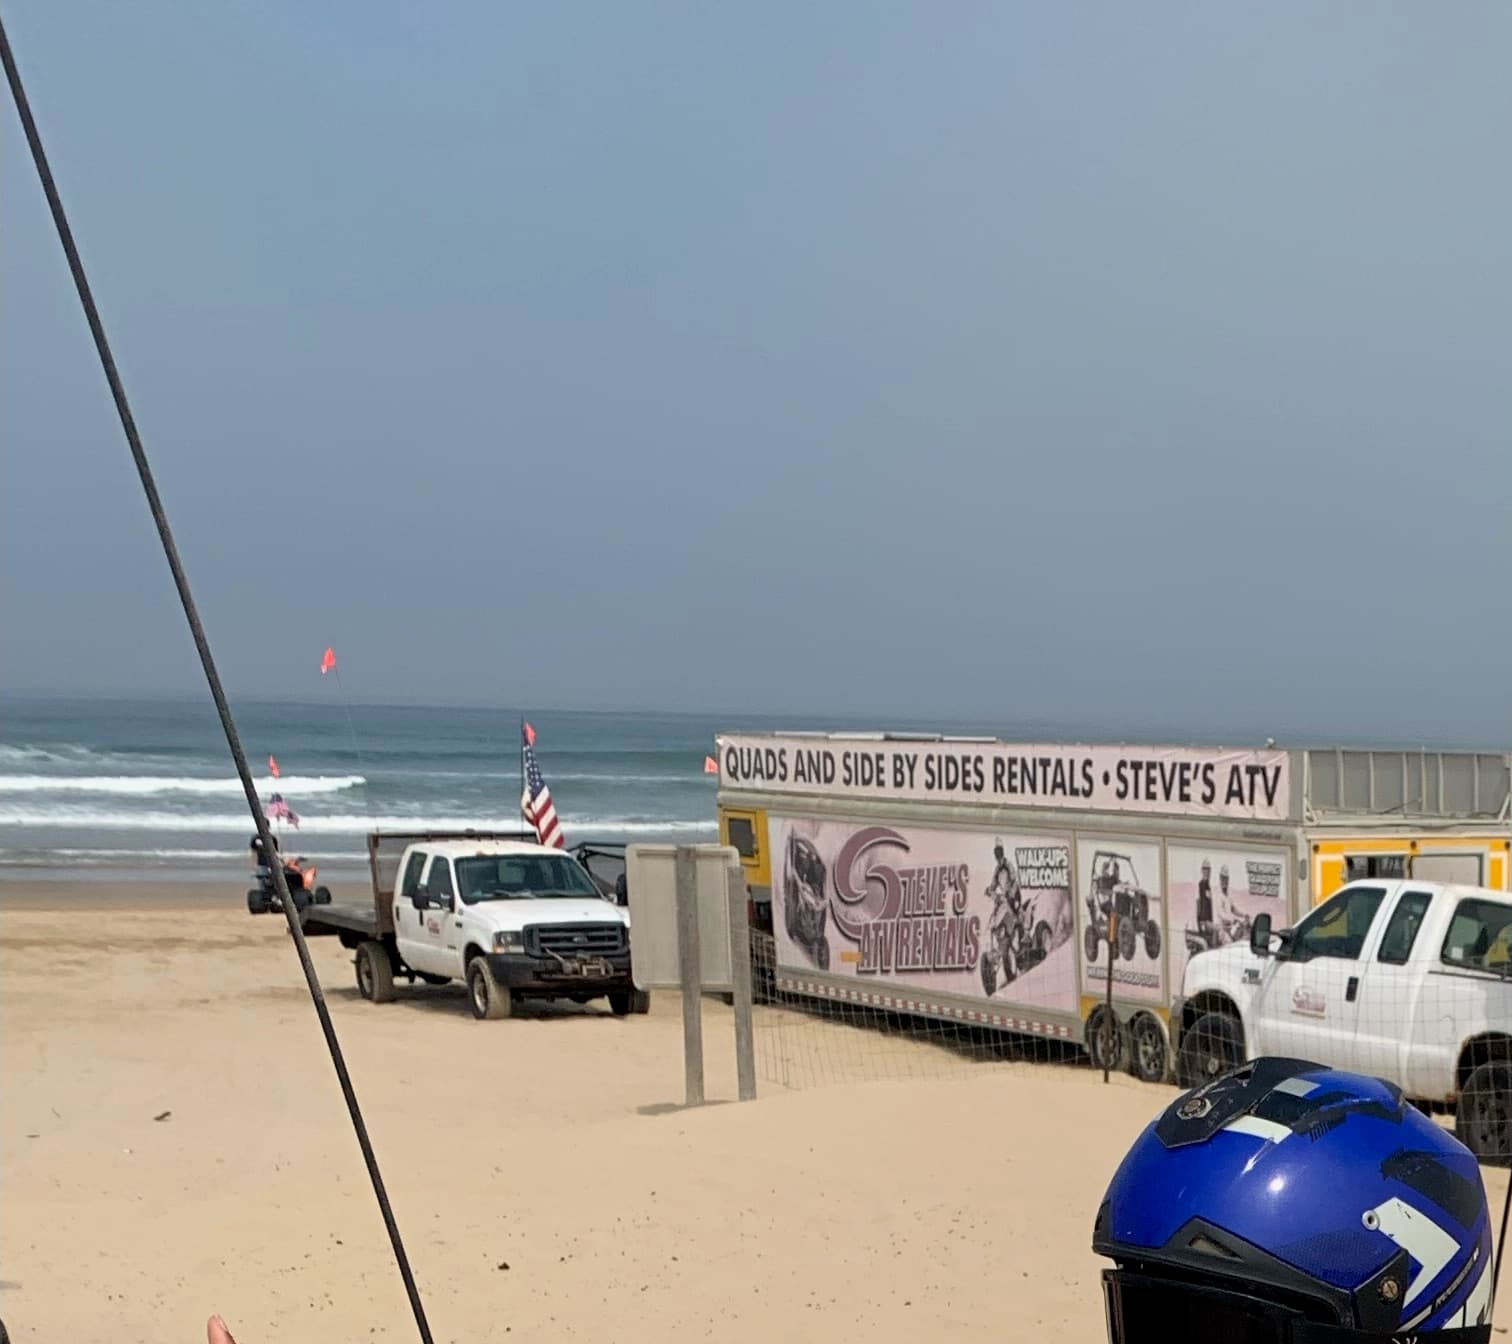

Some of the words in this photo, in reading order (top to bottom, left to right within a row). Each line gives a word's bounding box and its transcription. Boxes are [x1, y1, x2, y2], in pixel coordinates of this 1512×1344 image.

[726, 747, 788, 782] QUADS
[794, 750, 835, 785] AND
[843, 751, 885, 788] SIDE
[893, 753, 918, 789] BY
[925, 754, 984, 793] SIDES
[993, 756, 1093, 798] RENTALS
[1115, 759, 1216, 805] STEVE'S
[1225, 764, 1282, 807] ATV
[1015, 847, 1068, 868] WALK-UPS
[1018, 867, 1068, 889] WELCOME
[896, 914, 981, 973] RENTALS
